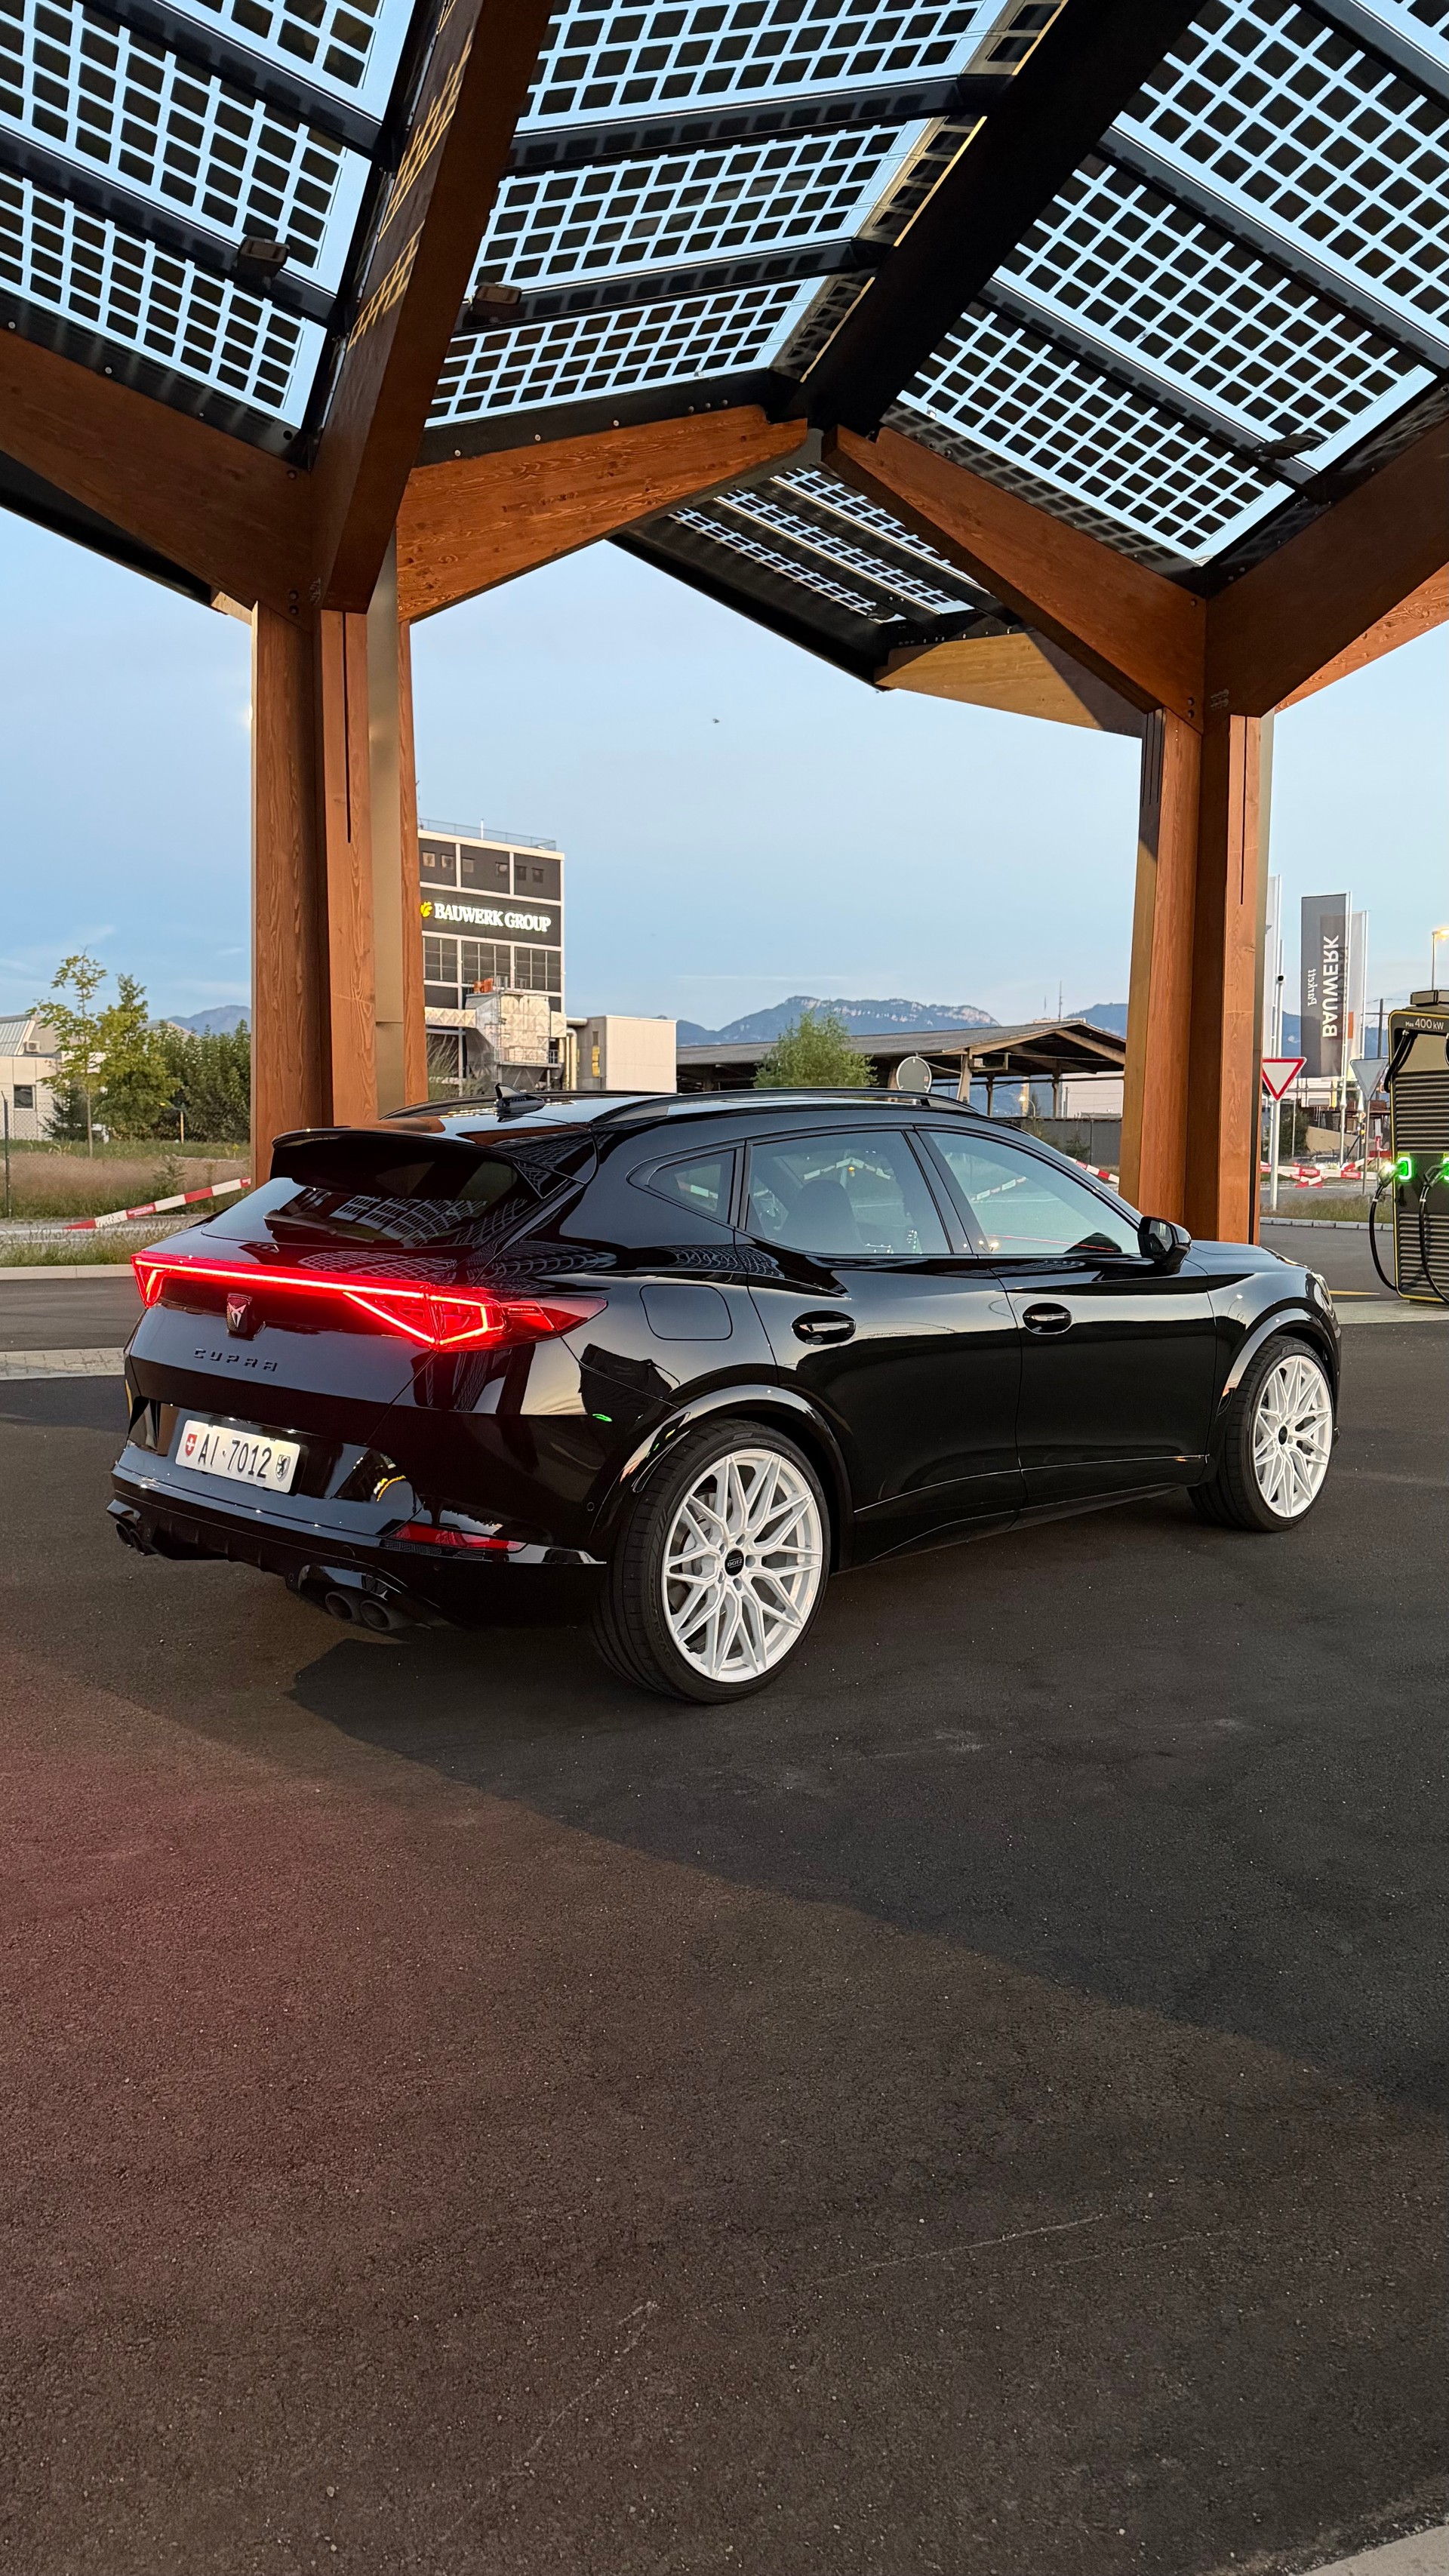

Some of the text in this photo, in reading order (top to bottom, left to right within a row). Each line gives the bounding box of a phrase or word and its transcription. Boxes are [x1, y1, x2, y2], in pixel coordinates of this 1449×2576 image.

[434, 903, 552, 932] BAUWERK GROUP
[1414, 1018, 1432, 1029] 400
[1432, 1021, 1444, 1030] kW
[194, 1348, 278, 1372] CUPRA
[227, 1439, 272, 1479] 7012
